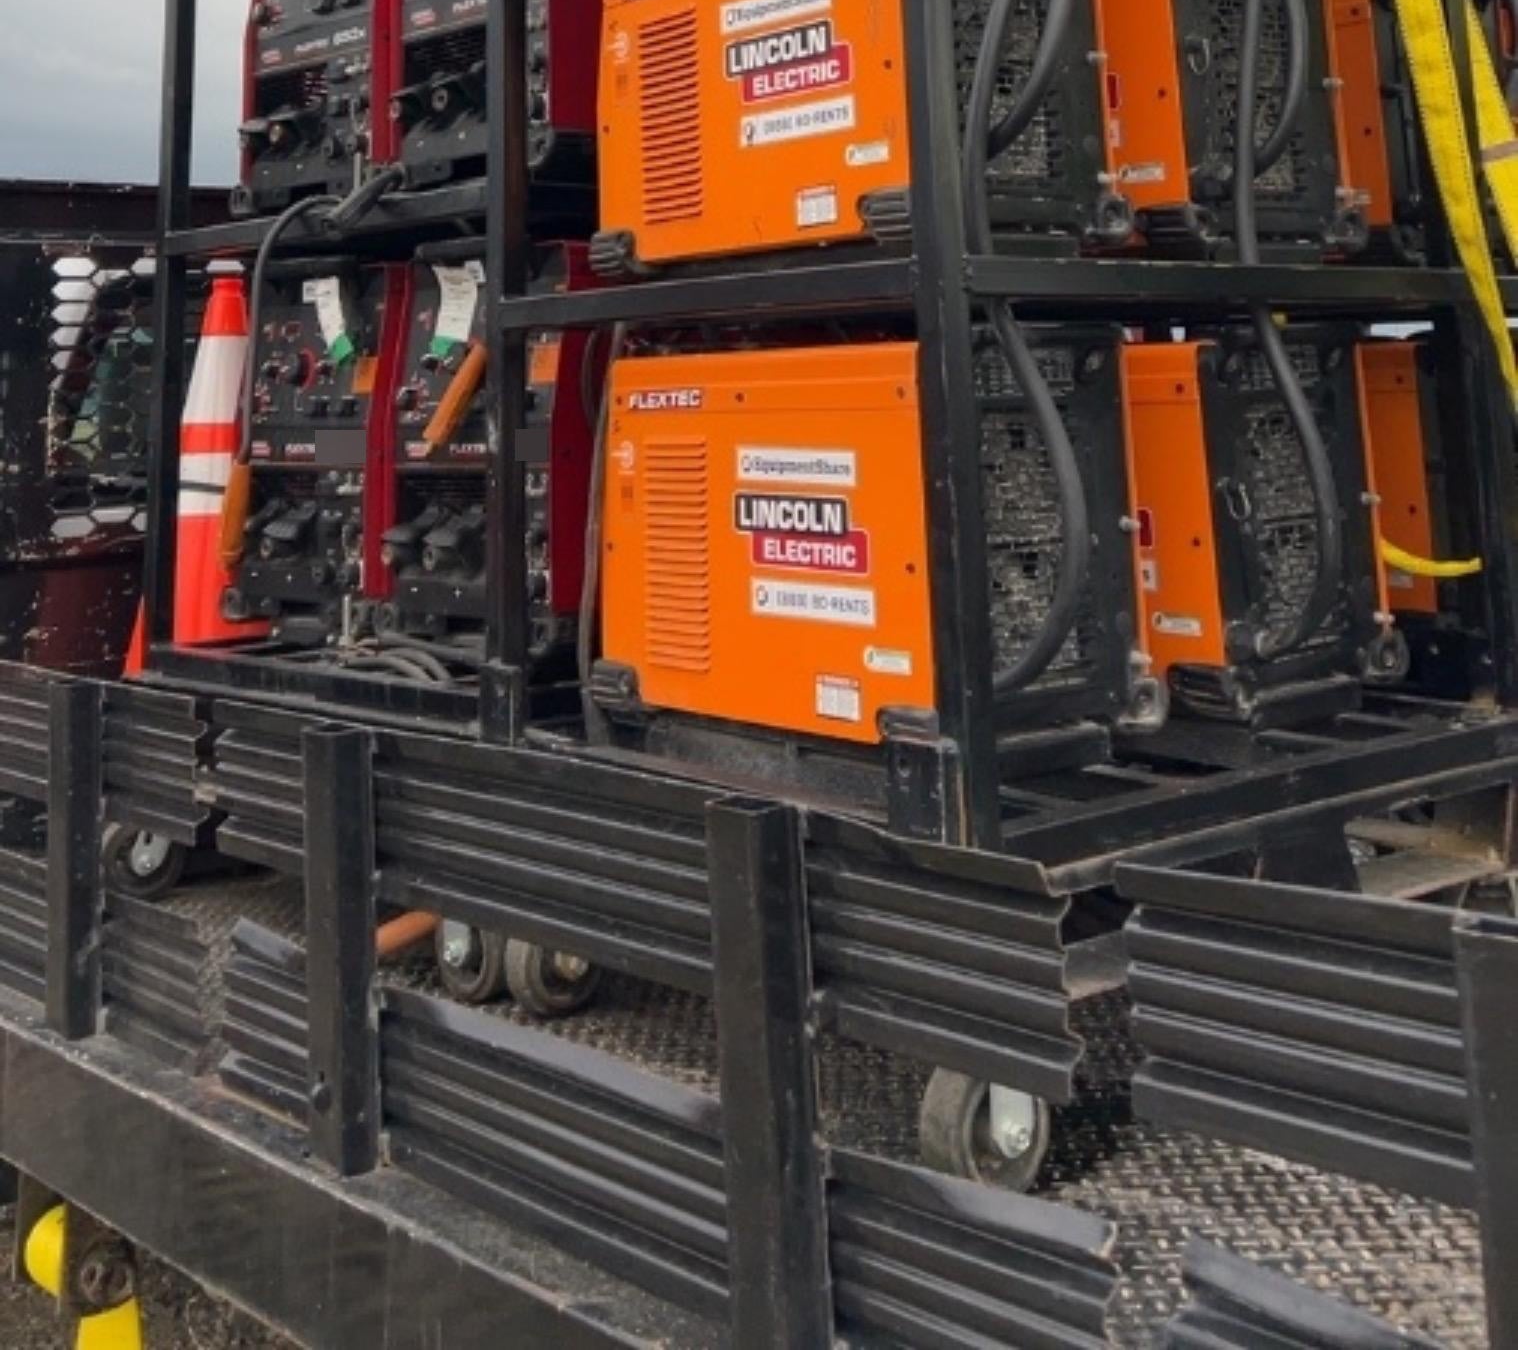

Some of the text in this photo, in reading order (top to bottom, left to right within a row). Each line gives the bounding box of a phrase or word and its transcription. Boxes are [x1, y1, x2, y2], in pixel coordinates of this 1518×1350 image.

[728, 25, 828, 73] LINCOLN
[751, 59, 841, 96] ELECTRIC
[628, 388, 702, 409] FLEXTEC
[739, 497, 843, 535] LINCOLN
[763, 538, 858, 568] ELECTRIC
